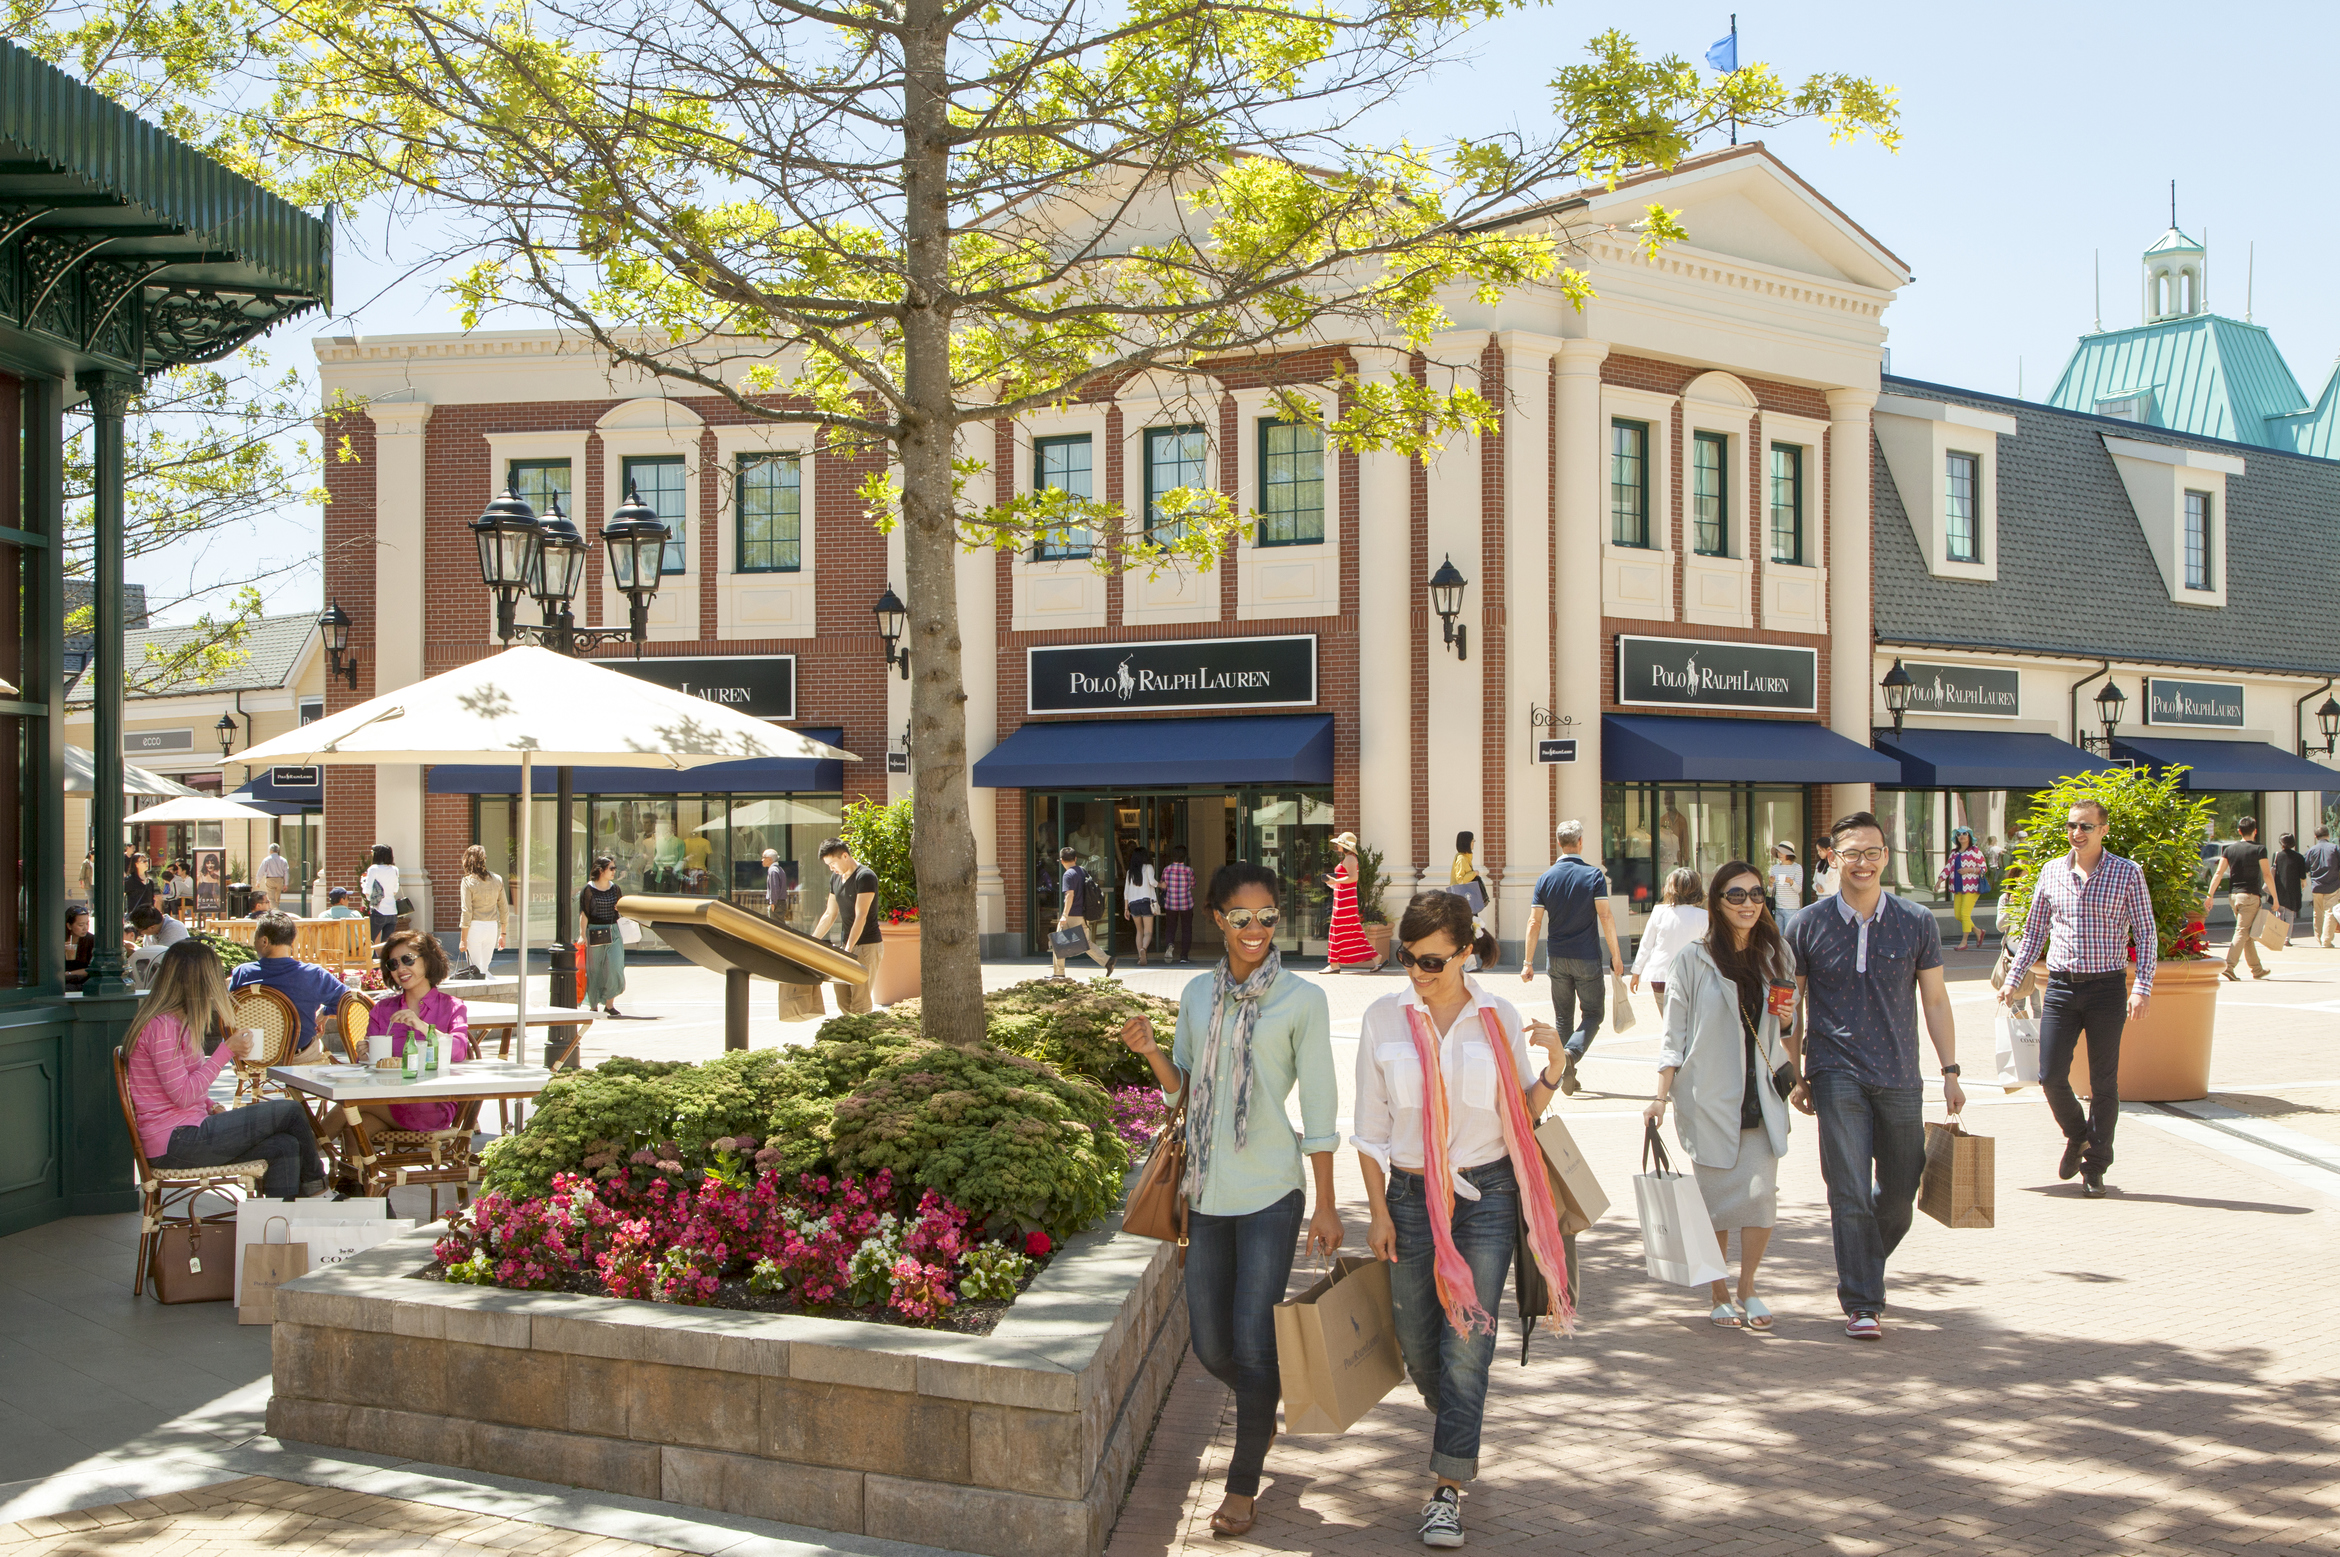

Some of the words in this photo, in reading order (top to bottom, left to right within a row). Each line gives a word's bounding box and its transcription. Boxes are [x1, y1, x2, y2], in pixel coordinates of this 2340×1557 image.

[1069, 672, 1116, 694] POLO
[1138, 669, 1197, 692] RALPH
[1199, 667, 1271, 689] LAUREN
[1652, 664, 1687, 688] POLO
[1701, 667, 1742, 691] RALPH
[1743, 669, 1789, 693] LAUREN
[1946, 684, 1978, 704] RALPH
[1979, 685, 2016, 706] LAUREN
[2153, 695, 2176, 714] POLO
[2184, 697, 2211, 716] RALPH
[2211, 699, 2241, 718] LAUREN
[142, 736, 162, 747] ecco
